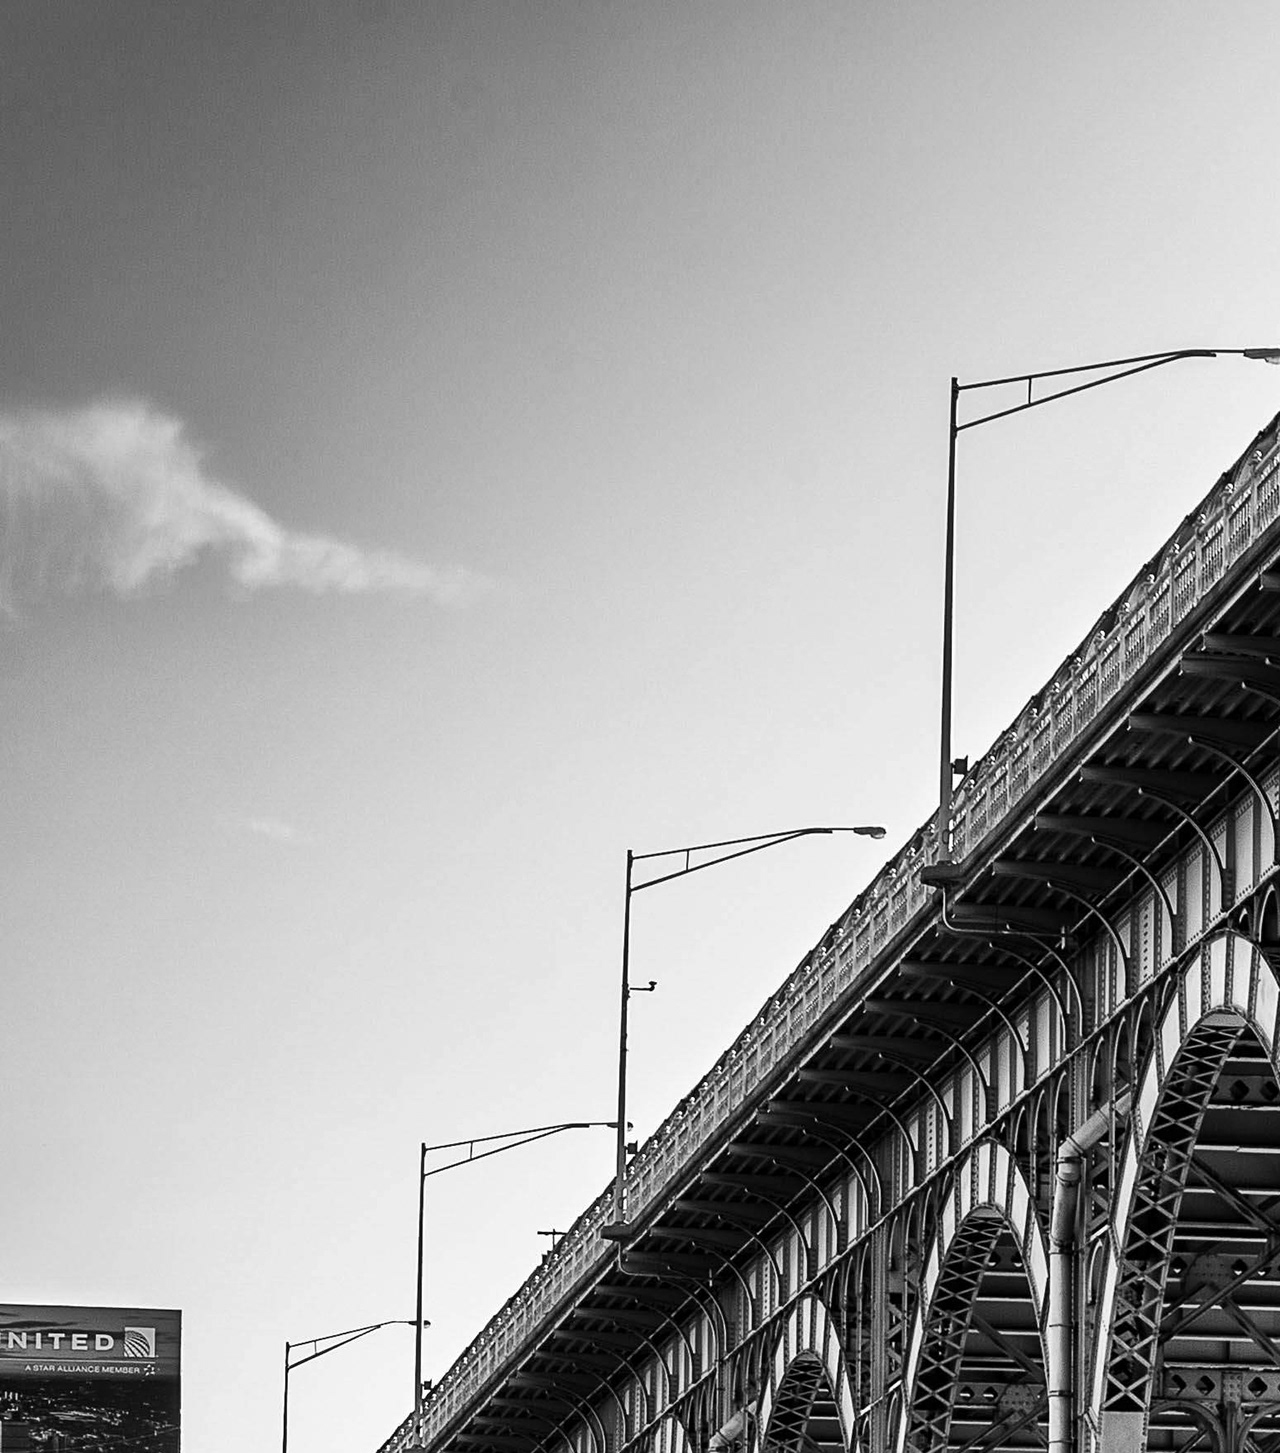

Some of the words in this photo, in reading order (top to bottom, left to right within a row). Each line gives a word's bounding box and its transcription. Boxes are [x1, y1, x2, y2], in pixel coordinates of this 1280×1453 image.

[0, 1331, 115, 1351] NITED
[57, 1365, 99, 1373] ALLIANCE
[102, 1366, 140, 1374] MEMBER
